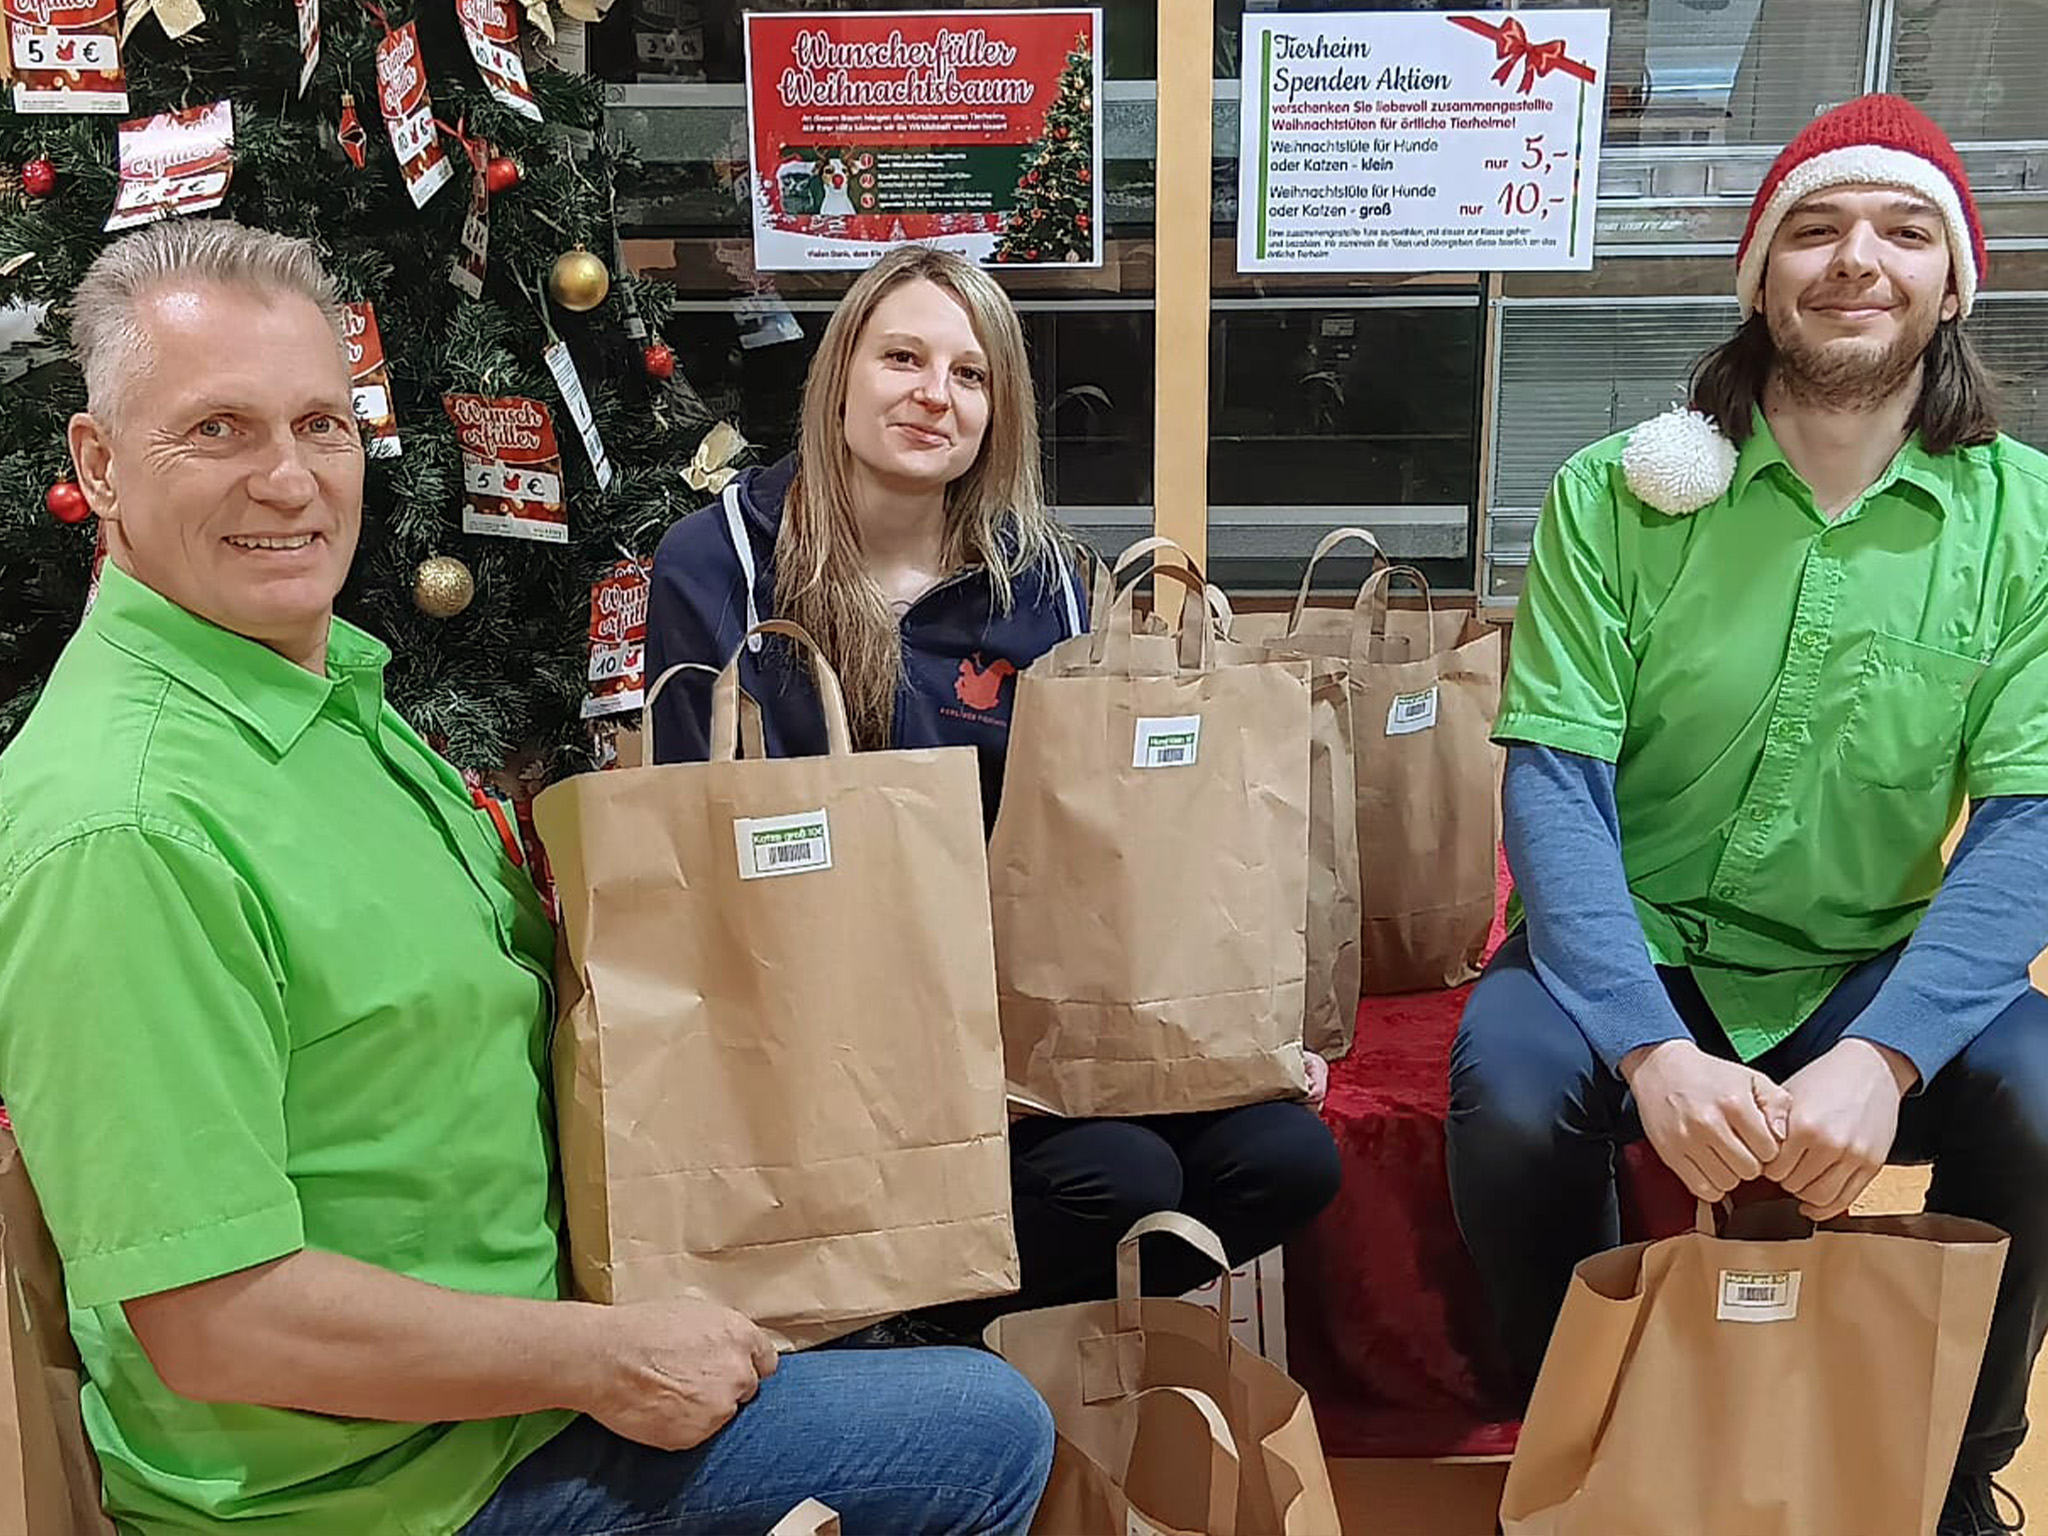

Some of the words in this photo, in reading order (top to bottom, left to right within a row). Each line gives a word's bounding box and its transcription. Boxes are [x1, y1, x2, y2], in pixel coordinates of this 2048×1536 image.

[28, 39, 44, 63] 5
[83, 40, 100, 63] €
[792, 29, 1018, 79] Wunscherfüller
[1273, 34, 1371, 60] Tierheim
[777, 68, 1034, 107] Weihnachtsbaum
[1273, 66, 1371, 103] Spenden
[1376, 66, 1452, 93] Aktion
[1353, 100, 1373, 113] Sie
[1376, 99, 1428, 113] liebevoll
[1430, 99, 1553, 115] zusammengestellte
[1272, 118, 1377, 131] Weihnachtstüten
[1380, 117, 1397, 130] für
[1400, 117, 1446, 130] örtliche
[1450, 116, 1516, 129] Tierheime!
[1270, 139, 1370, 153] Weihnachtstüte
[1373, 138, 1391, 152] für
[1394, 138, 1439, 152] Hunde
[1270, 159, 1300, 171] oder
[1304, 158, 1348, 172] Katzen
[1361, 157, 1394, 171] klein
[1485, 159, 1509, 169] nur
[1270, 185, 1368, 199] Weihnachtstüte
[1372, 183, 1389, 198] für
[1392, 184, 1437, 198] Hunde
[1268, 204, 1299, 217] oder
[1302, 204, 1347, 217] Katzen
[1359, 202, 1391, 219] groß
[1460, 205, 1484, 216] nur
[352, 394, 369, 416] €
[454, 400, 543, 427] Wunsch
[462, 420, 541, 458] erfüller
[477, 472, 492, 489] 5
[527, 477, 546, 497] €
[596, 655, 616, 676] 10
